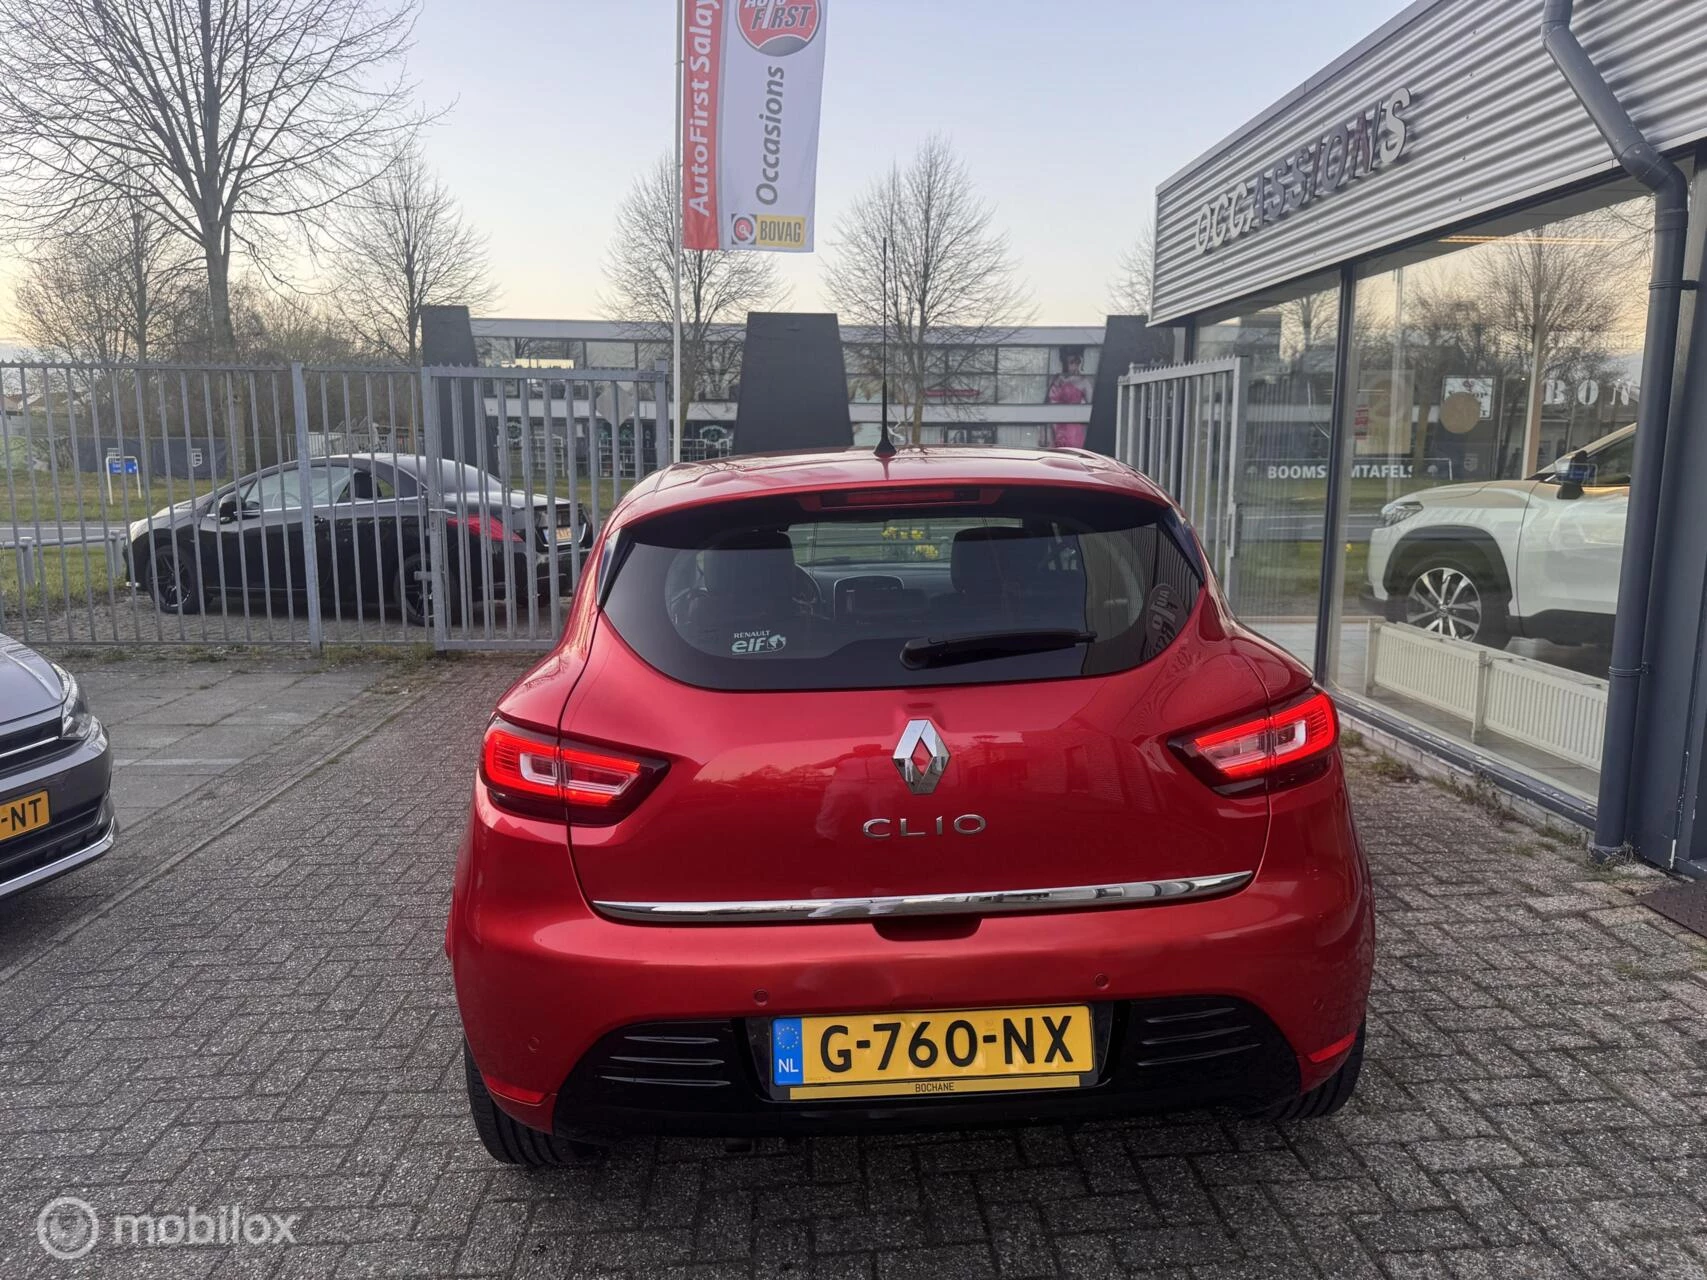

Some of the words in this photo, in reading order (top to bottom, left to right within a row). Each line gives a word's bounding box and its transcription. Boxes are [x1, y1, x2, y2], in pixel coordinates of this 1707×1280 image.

[751, 5, 812, 30] FIRST
[689, 78, 710, 217] AutoFirst
[756, 65, 785, 205] Occasions
[760, 220, 802, 242] BOVAG
[731, 638, 766, 653] elf
[733, 630, 770, 639] RENAULT
[863, 814, 986, 839] CLIO
[778, 1058, 799, 1074] NL
[820, 1015, 1074, 1073] G-760-NX
[915, 1081, 955, 1093] BOCHANE
